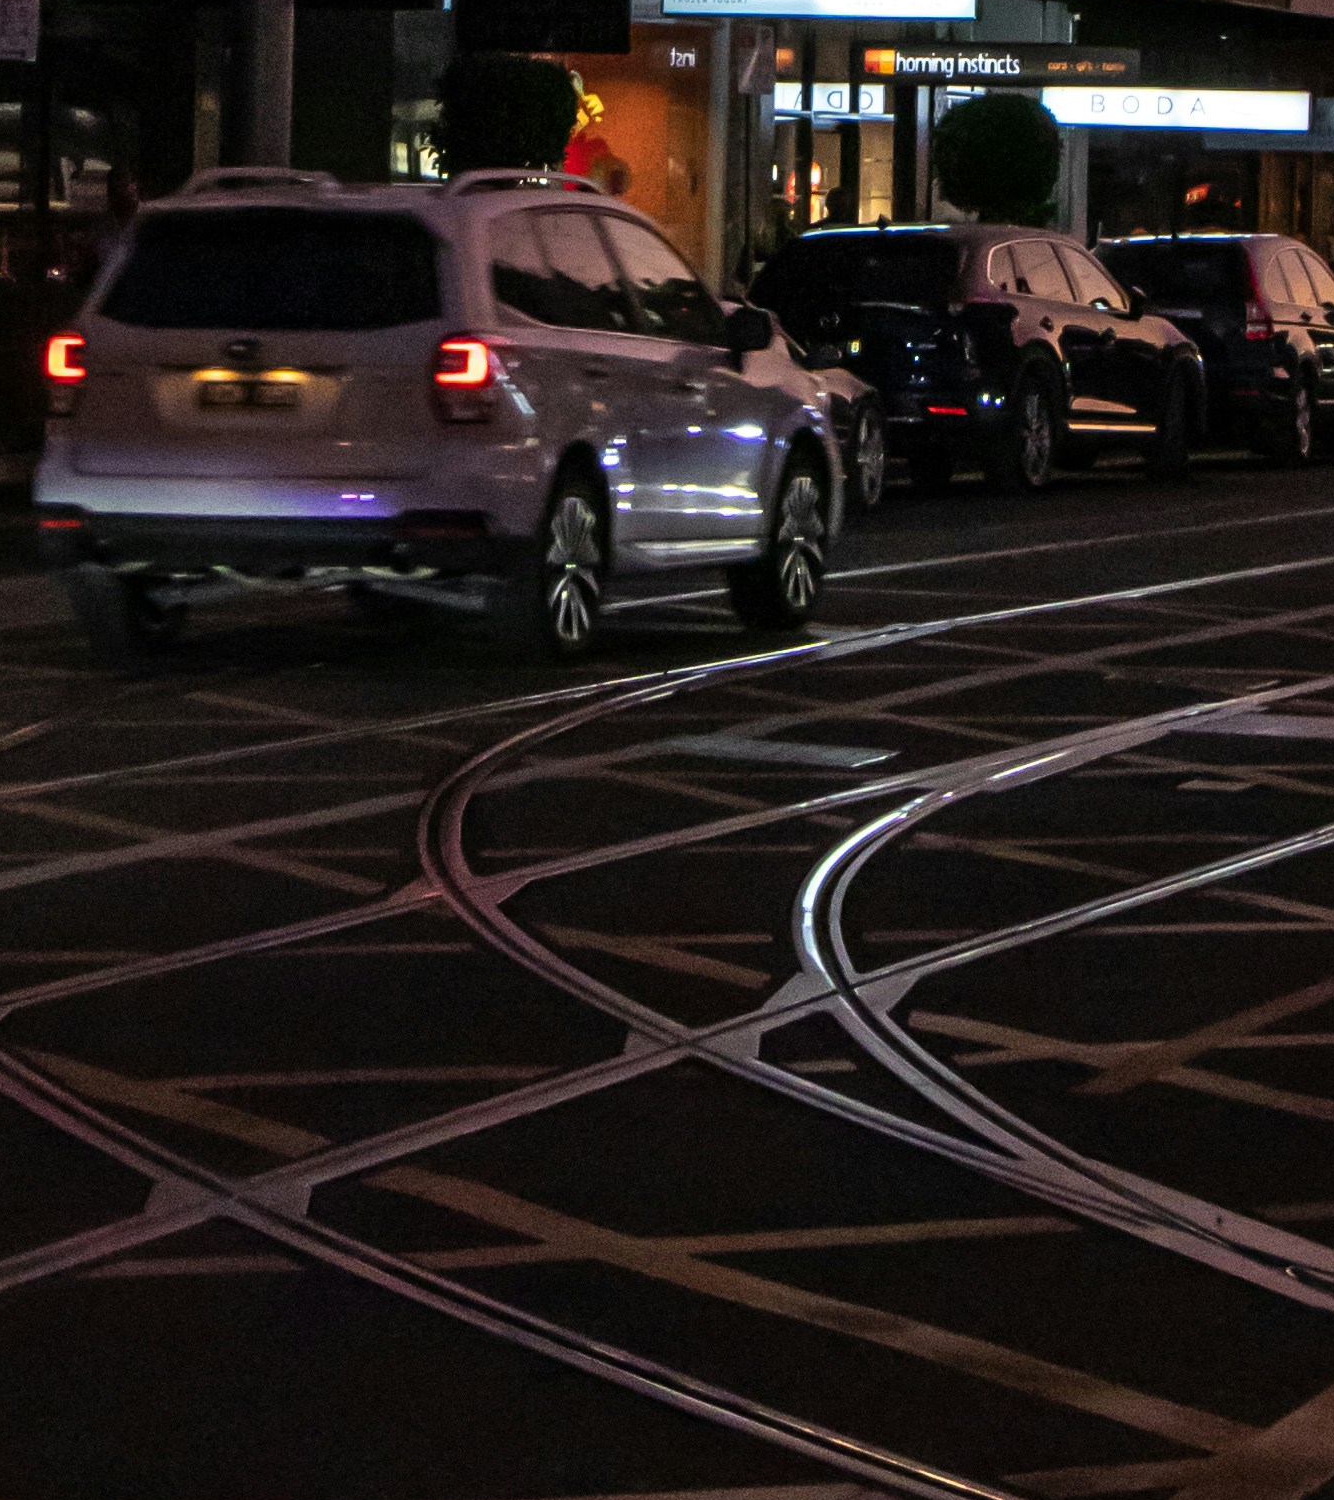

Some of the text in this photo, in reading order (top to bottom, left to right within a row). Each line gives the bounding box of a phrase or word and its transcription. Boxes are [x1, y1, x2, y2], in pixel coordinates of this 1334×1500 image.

[896, 52, 1021, 78] homing instincts
[1090, 93, 1206, 116] BODA
